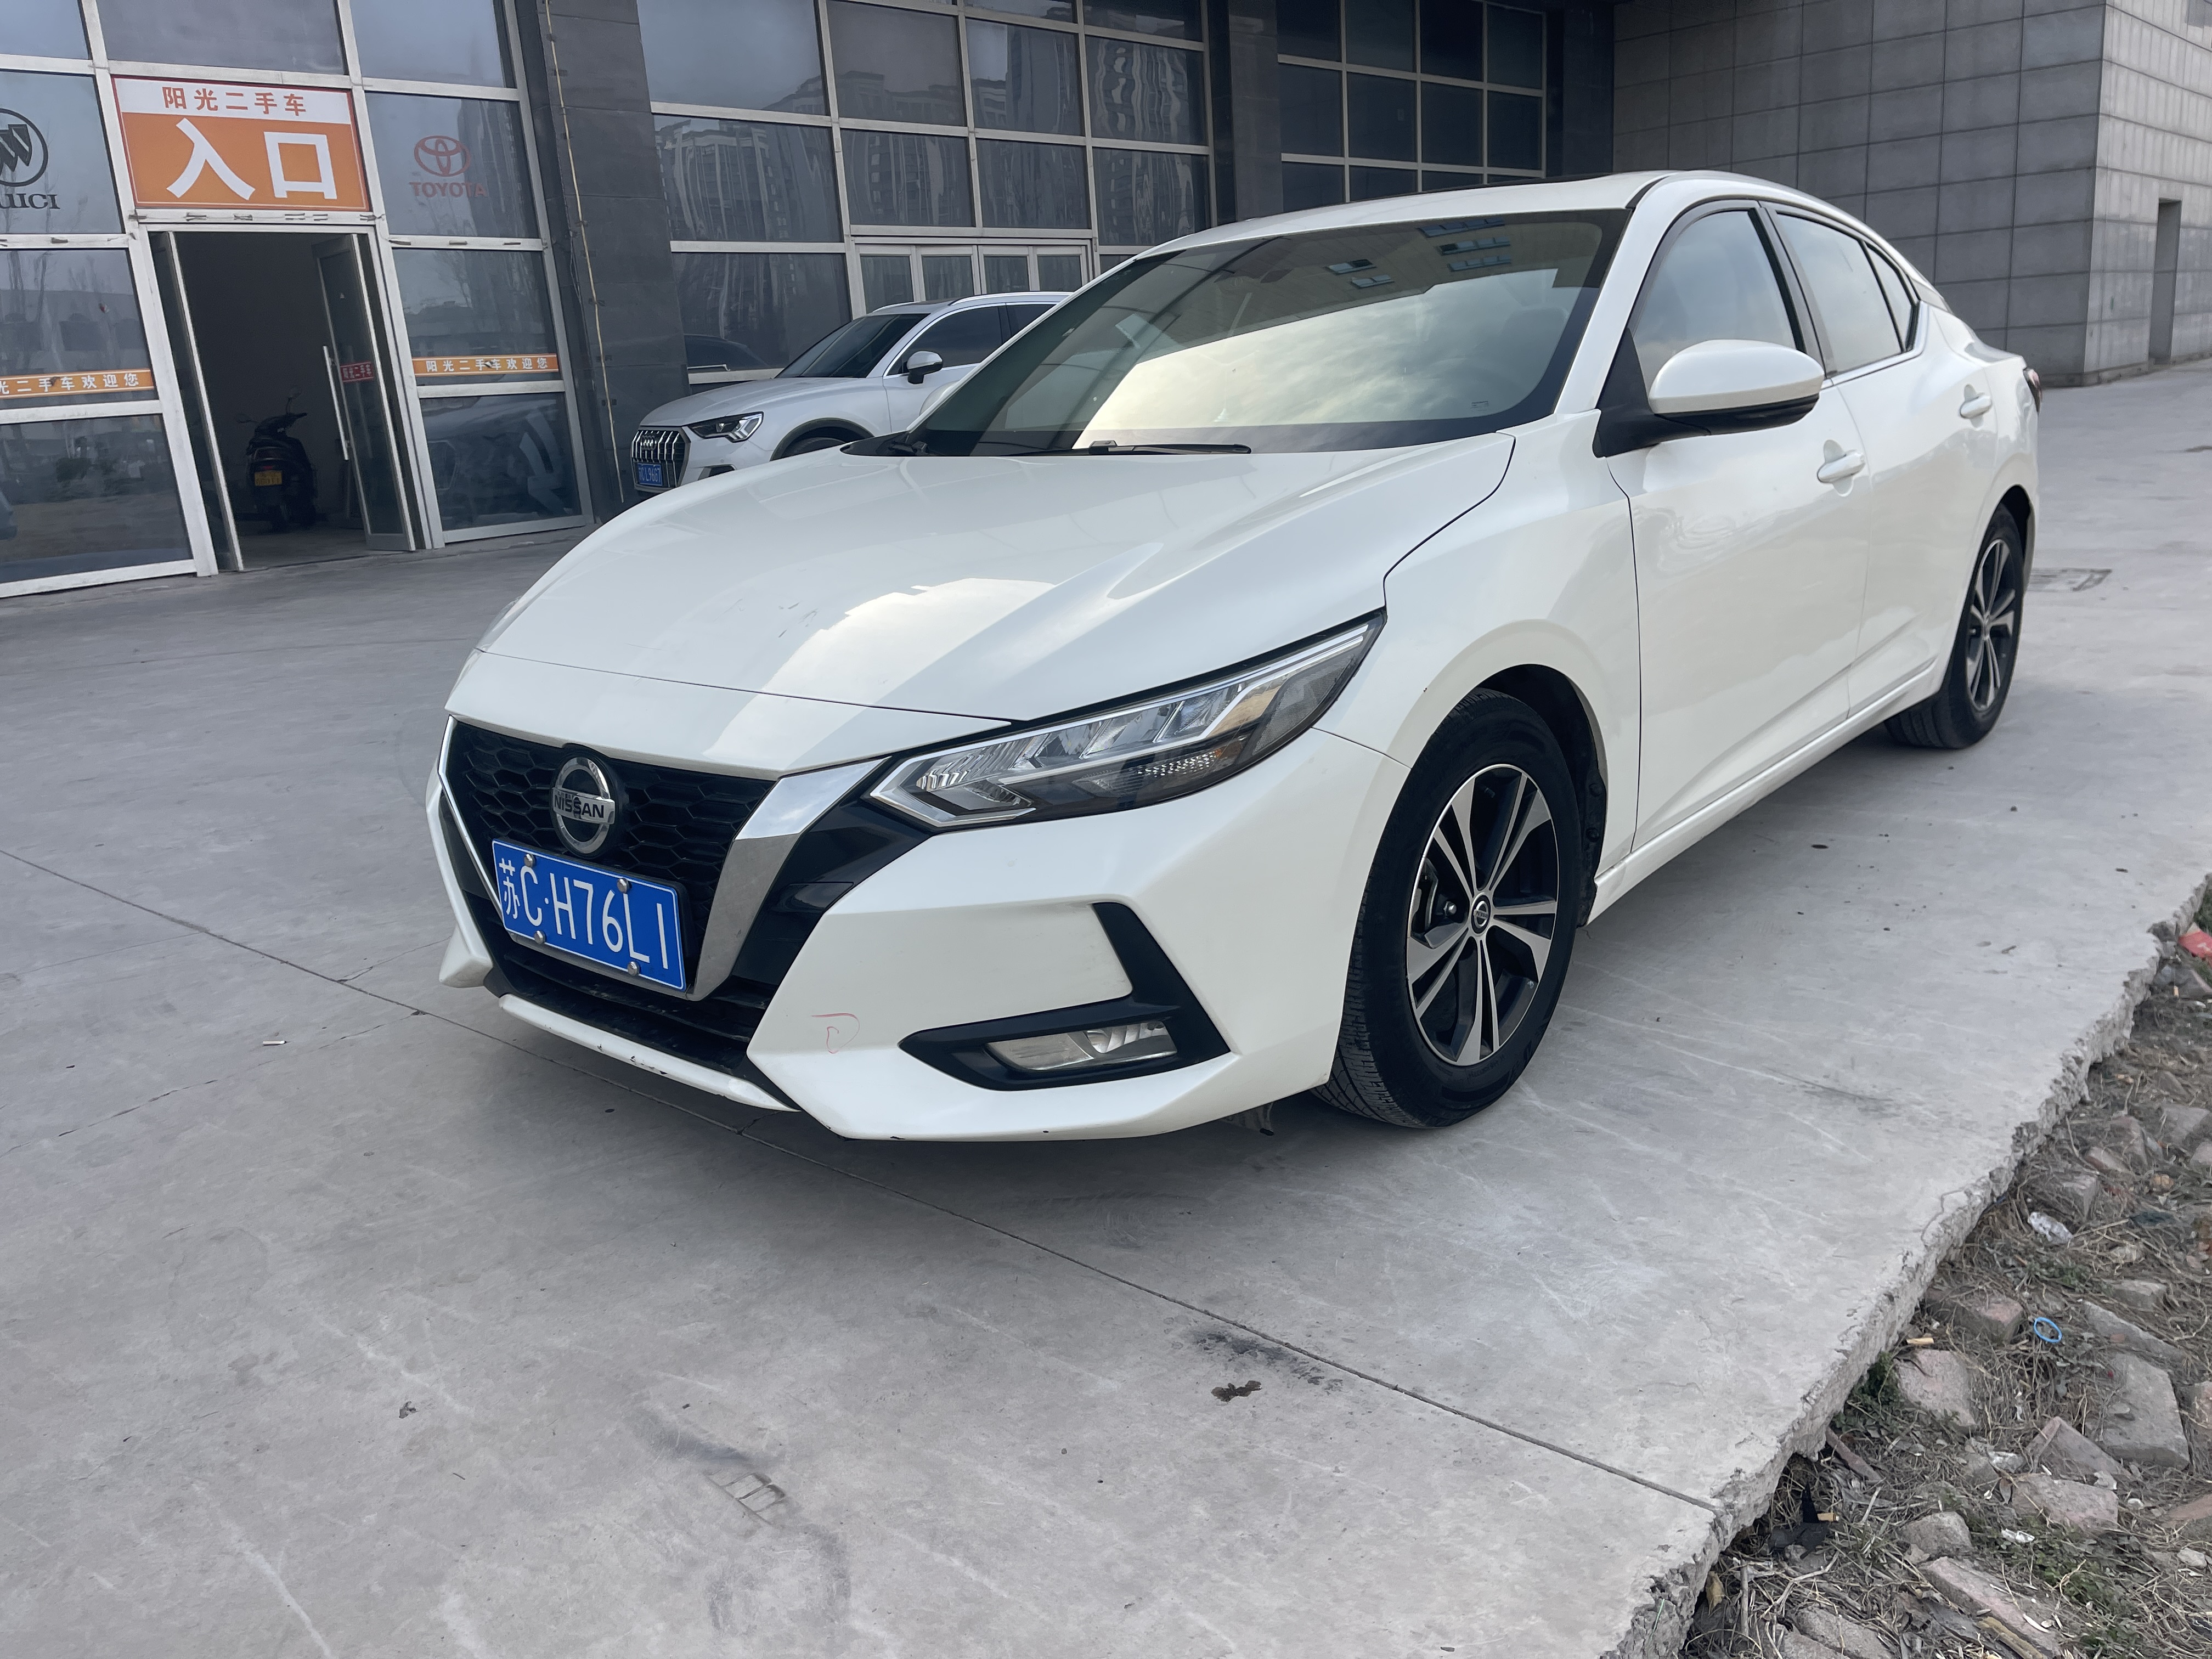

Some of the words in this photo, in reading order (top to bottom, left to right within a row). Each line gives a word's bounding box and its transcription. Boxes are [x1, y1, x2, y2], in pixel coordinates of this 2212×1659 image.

[162, 86, 306, 116] 阳光二手车
[166, 117, 337, 200] 入口
[408, 182, 488, 199] TOYOTA
[426, 357, 548, 373] 阳光二手车欢迎您
[554, 794, 604, 818] NISSAN
